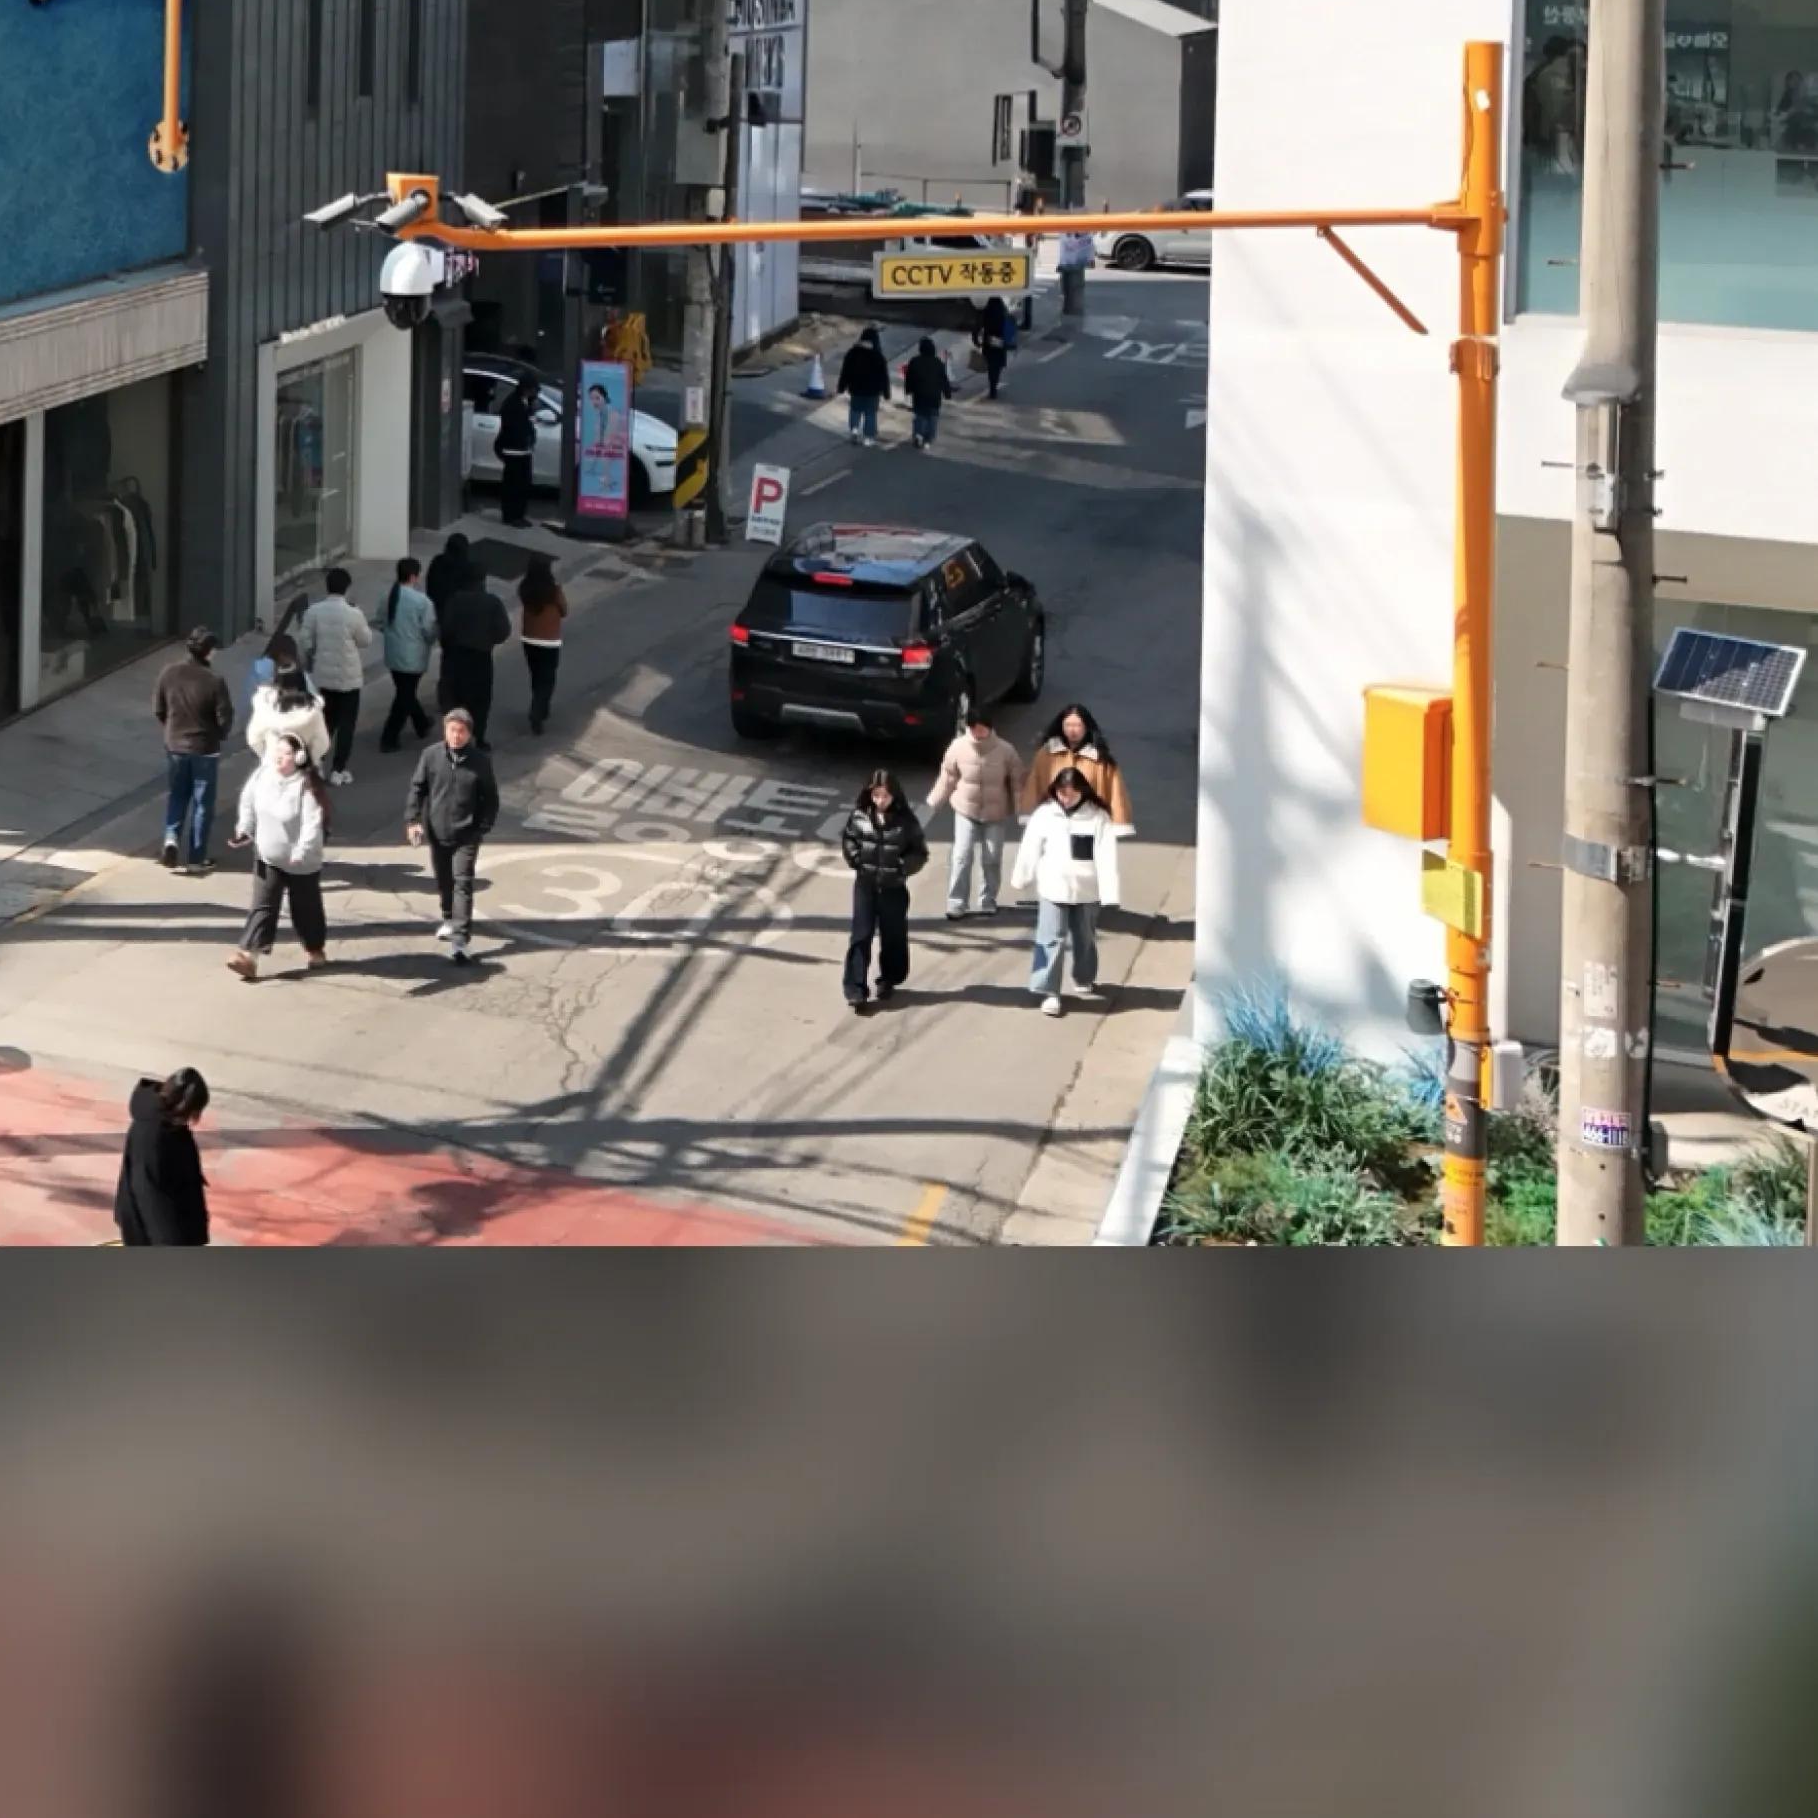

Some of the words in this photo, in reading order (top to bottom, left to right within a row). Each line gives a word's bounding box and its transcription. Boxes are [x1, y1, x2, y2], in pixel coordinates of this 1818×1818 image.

[891, 264, 953, 286] CCTV
[960, 261, 1016, 285] 작동중
[754, 477, 783, 514] P
